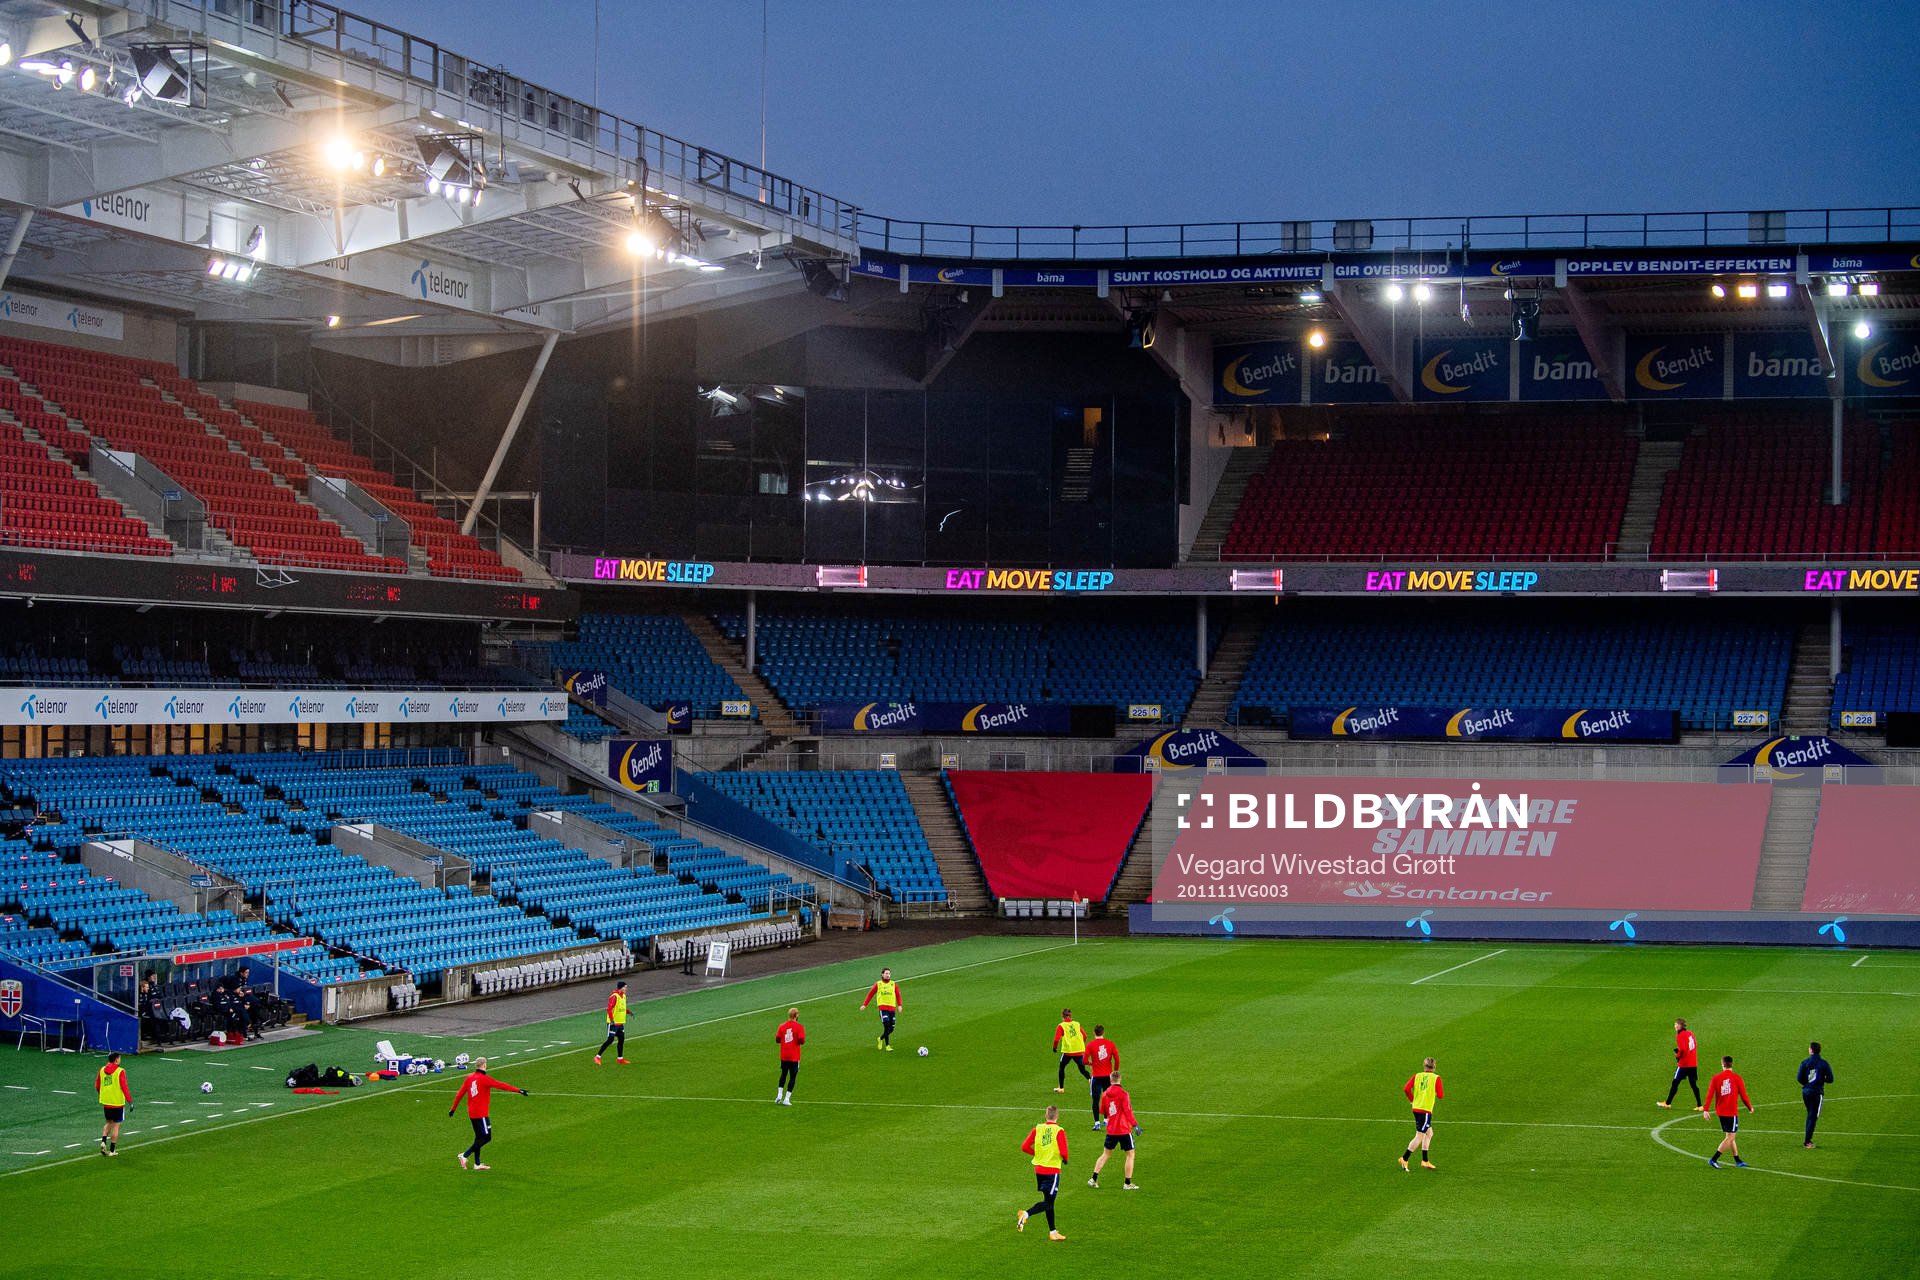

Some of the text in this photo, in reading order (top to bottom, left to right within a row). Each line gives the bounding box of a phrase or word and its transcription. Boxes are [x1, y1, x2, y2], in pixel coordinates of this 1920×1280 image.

[95, 193, 150, 222] telenor
[1335, 264, 1449, 276] GIR OVERSKUDD
[1499, 259, 1521, 272] Bendit
[1567, 258, 1791, 272] OPPLEV BENDIT-EFFEKTEN
[1832, 257, 1862, 269] bama
[1036, 272, 1065, 283] bama
[1114, 266, 1322, 282] SUNT KOSTHOLD OG AKTIVITET
[429, 271, 469, 299] telenor
[11, 301, 38, 317] telenor
[78, 311, 104, 327] telenor
[1242, 352, 1296, 385] Bendit
[1442, 349, 1498, 383] Bendit
[1657, 345, 1714, 379] Bendit
[1748, 352, 1823, 377] bama
[1324, 359, 1379, 384] bam
[594, 558, 715, 583] EAT MOVE SLEEP
[945, 569, 1114, 591] EAT MOVE SLEEP
[1365, 570, 1538, 591] EAT MOVE SLEEP
[1804, 569, 1919, 590] EAT MOVE
[575, 672, 606, 696] Bendit
[35, 698, 68, 715] telenor
[108, 699, 138, 715] telenor
[176, 699, 204, 714] telenor
[239, 699, 267, 714] telenor
[299, 699, 325, 713] telenor
[355, 700, 379, 713] telenor
[408, 700, 430, 713] telenor
[458, 700, 479, 713] telenor
[506, 699, 526, 713] telenor
[547, 700, 566, 712] telenor
[672, 706, 689, 719] Bendit
[725, 705, 739, 713] 223
[1132, 709, 1148, 717] 225
[871, 703, 917, 729] Bendit
[980, 703, 1029, 730] Bendit
[1350, 706, 1399, 734] Bendit
[1464, 708, 1514, 736] Bendit
[1581, 710, 1632, 737] Bendit
[1737, 715, 1753, 724] 227
[1855, 716, 1873, 724] 228
[1168, 731, 1220, 760] Bendit
[1775, 738, 1832, 768] Bendit
[631, 742, 663, 778] Bendit
[1372, 828, 1558, 857] SAMMEN
[1386, 884, 1553, 901] Santander
